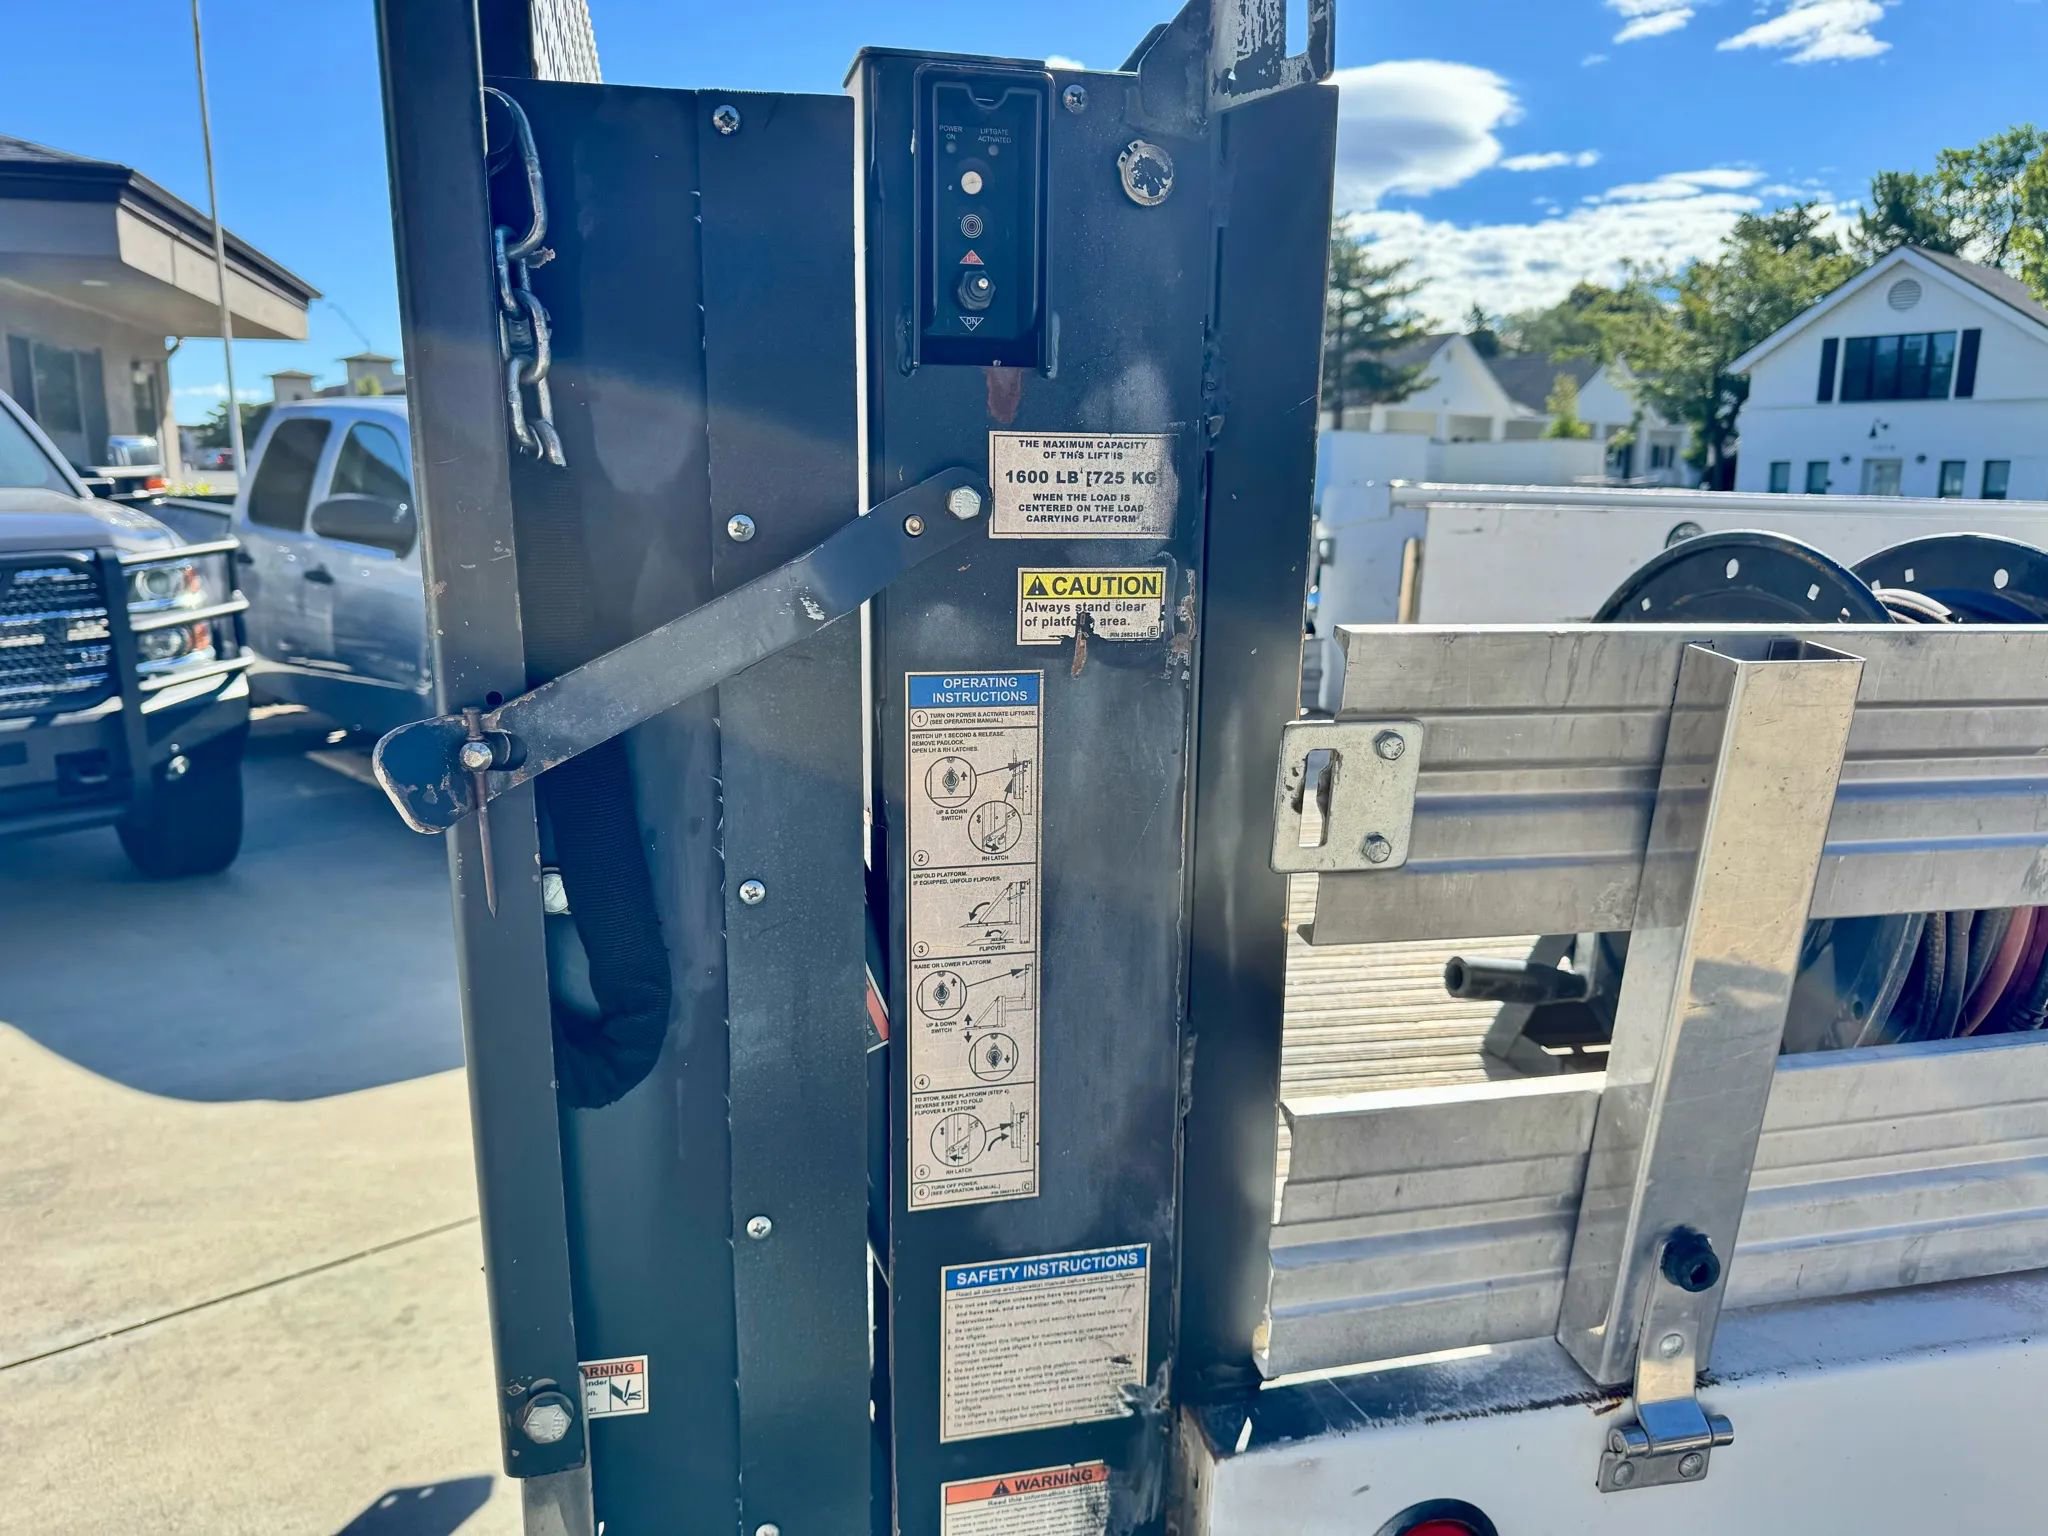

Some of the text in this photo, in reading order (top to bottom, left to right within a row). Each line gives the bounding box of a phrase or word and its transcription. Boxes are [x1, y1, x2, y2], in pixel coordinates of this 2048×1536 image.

[980, 128, 1009, 136] LIFTGATE
[1042, 440, 1093, 448] MAXIMUM
[1096, 441, 1147, 449] CAPACITY
[1059, 450, 1084, 459] THIS
[1005, 470, 1048, 483] 1600
[1056, 471, 1079, 483] LB
[1086, 471, 1125, 487] [725
[1052, 576, 1156, 595] CAUTION
[1025, 601, 1146, 614] Always stand clear
[1025, 616, 1037, 626] of
[1100, 618, 1130, 626] area.
[943, 677, 1017, 688] OPERATING
[932, 690, 1027, 702] INSTRUCTIONS
[957, 1265, 1018, 1285] SAFETY
[1023, 1252, 1138, 1277] INSTRUCTIONS
[584, 1364, 634, 1376] RNING
[1014, 1469, 1093, 1492] WARNING
